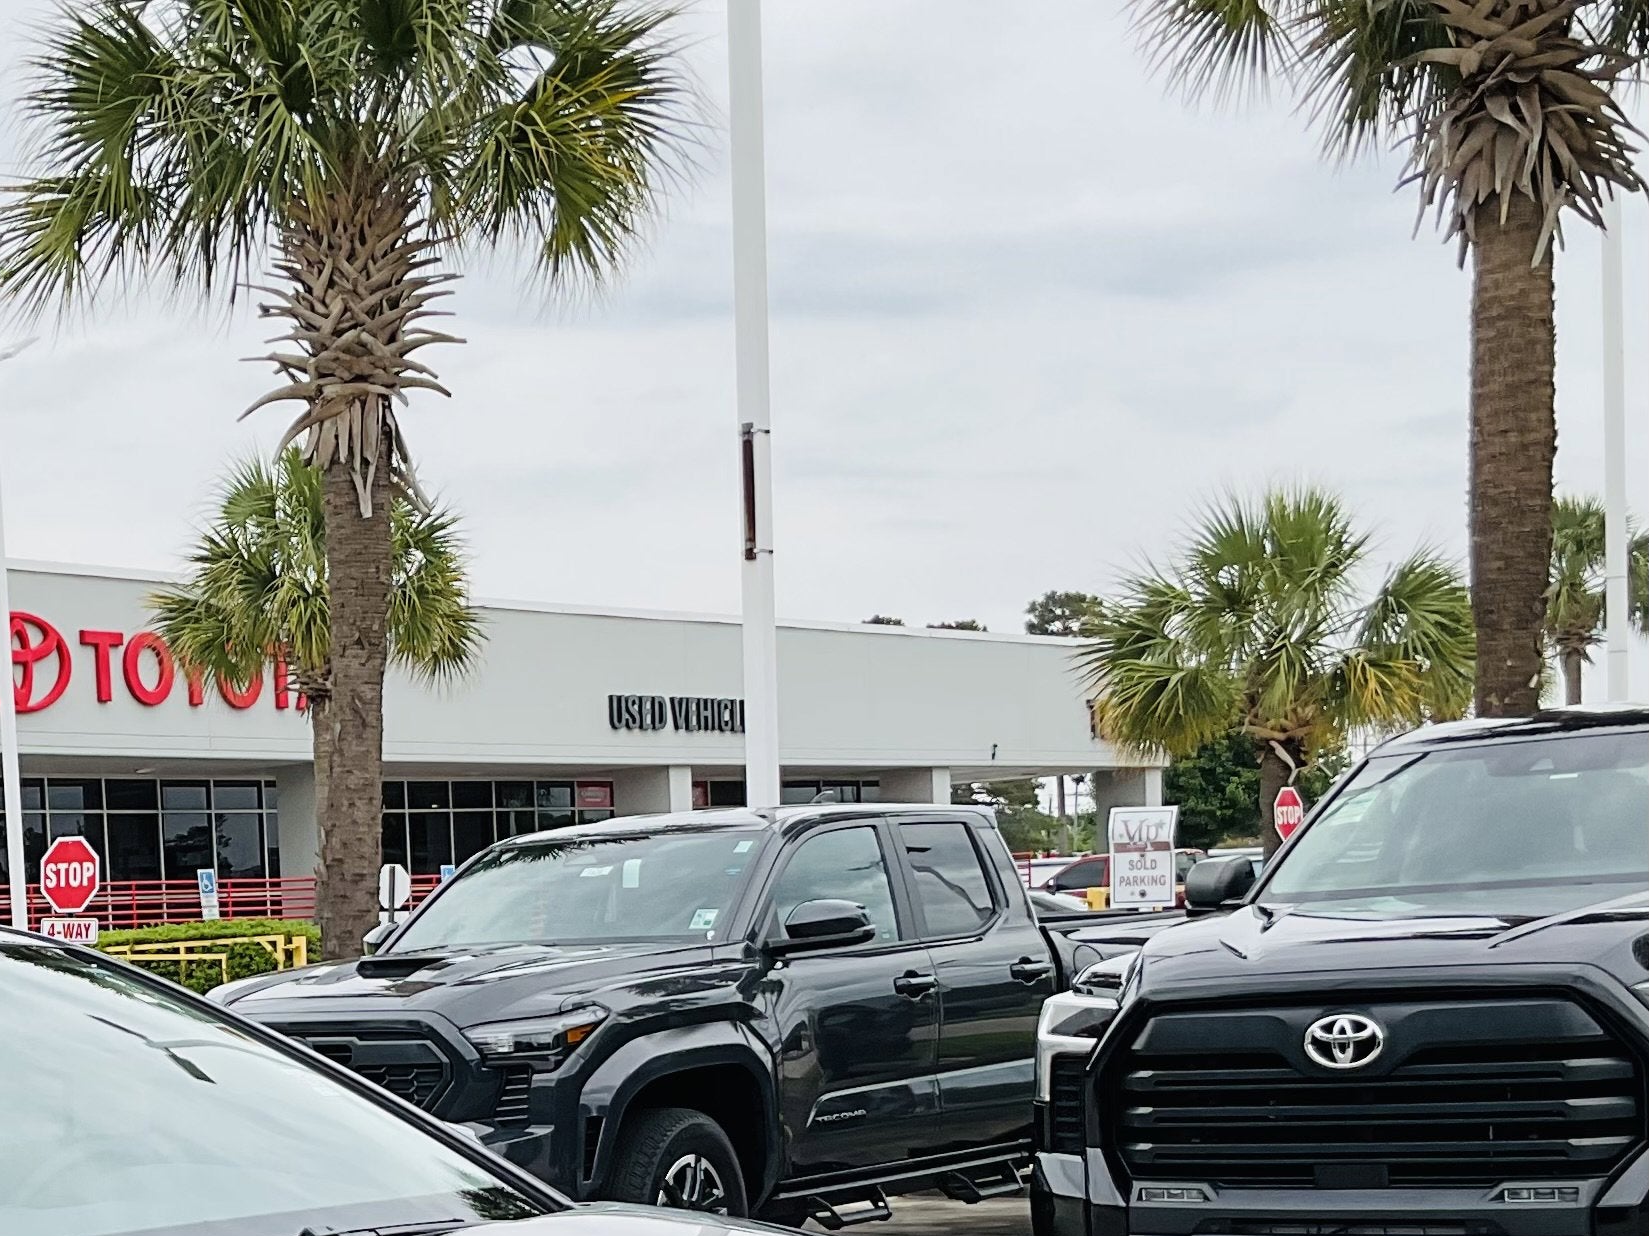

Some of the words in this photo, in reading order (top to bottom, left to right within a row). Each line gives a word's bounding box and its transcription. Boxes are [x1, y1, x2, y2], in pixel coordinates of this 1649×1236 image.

[79, 630, 307, 710] TOYOT
[608, 695, 667, 730] USED
[669, 697, 745, 733] VEHICL
[1277, 805, 1301, 825] STOP
[45, 861, 95, 888] STOP
[1128, 859, 1157, 871] SOLD
[1119, 874, 1167, 887] PARKING
[47, 922, 91, 940] 4-WAY
